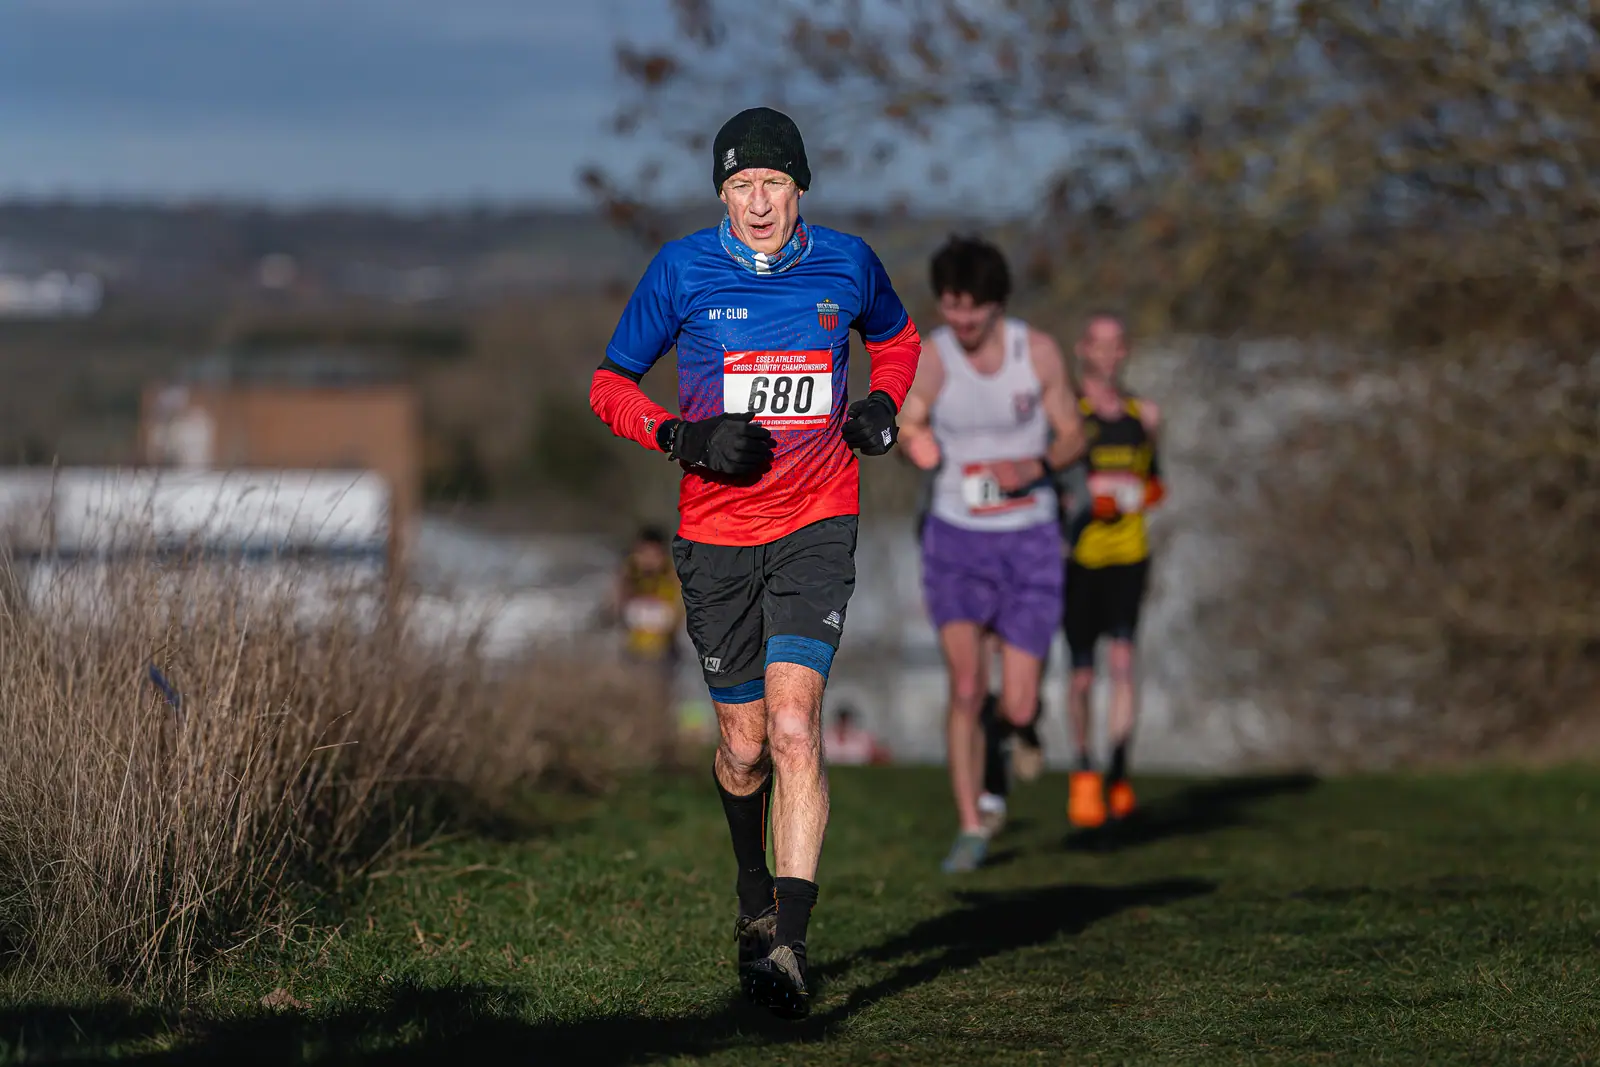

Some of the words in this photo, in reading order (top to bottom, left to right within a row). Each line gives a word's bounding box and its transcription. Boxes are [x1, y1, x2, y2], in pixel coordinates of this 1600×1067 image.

[755, 355, 775, 363] ESSEX
[775, 355, 807, 363] ATHLETICS
[732, 364, 752, 372] CROSS
[753, 363, 781, 372] COUNTRY
[781, 363, 828, 372] CHAMPIONSHIPS
[747, 376, 815, 414] 680
